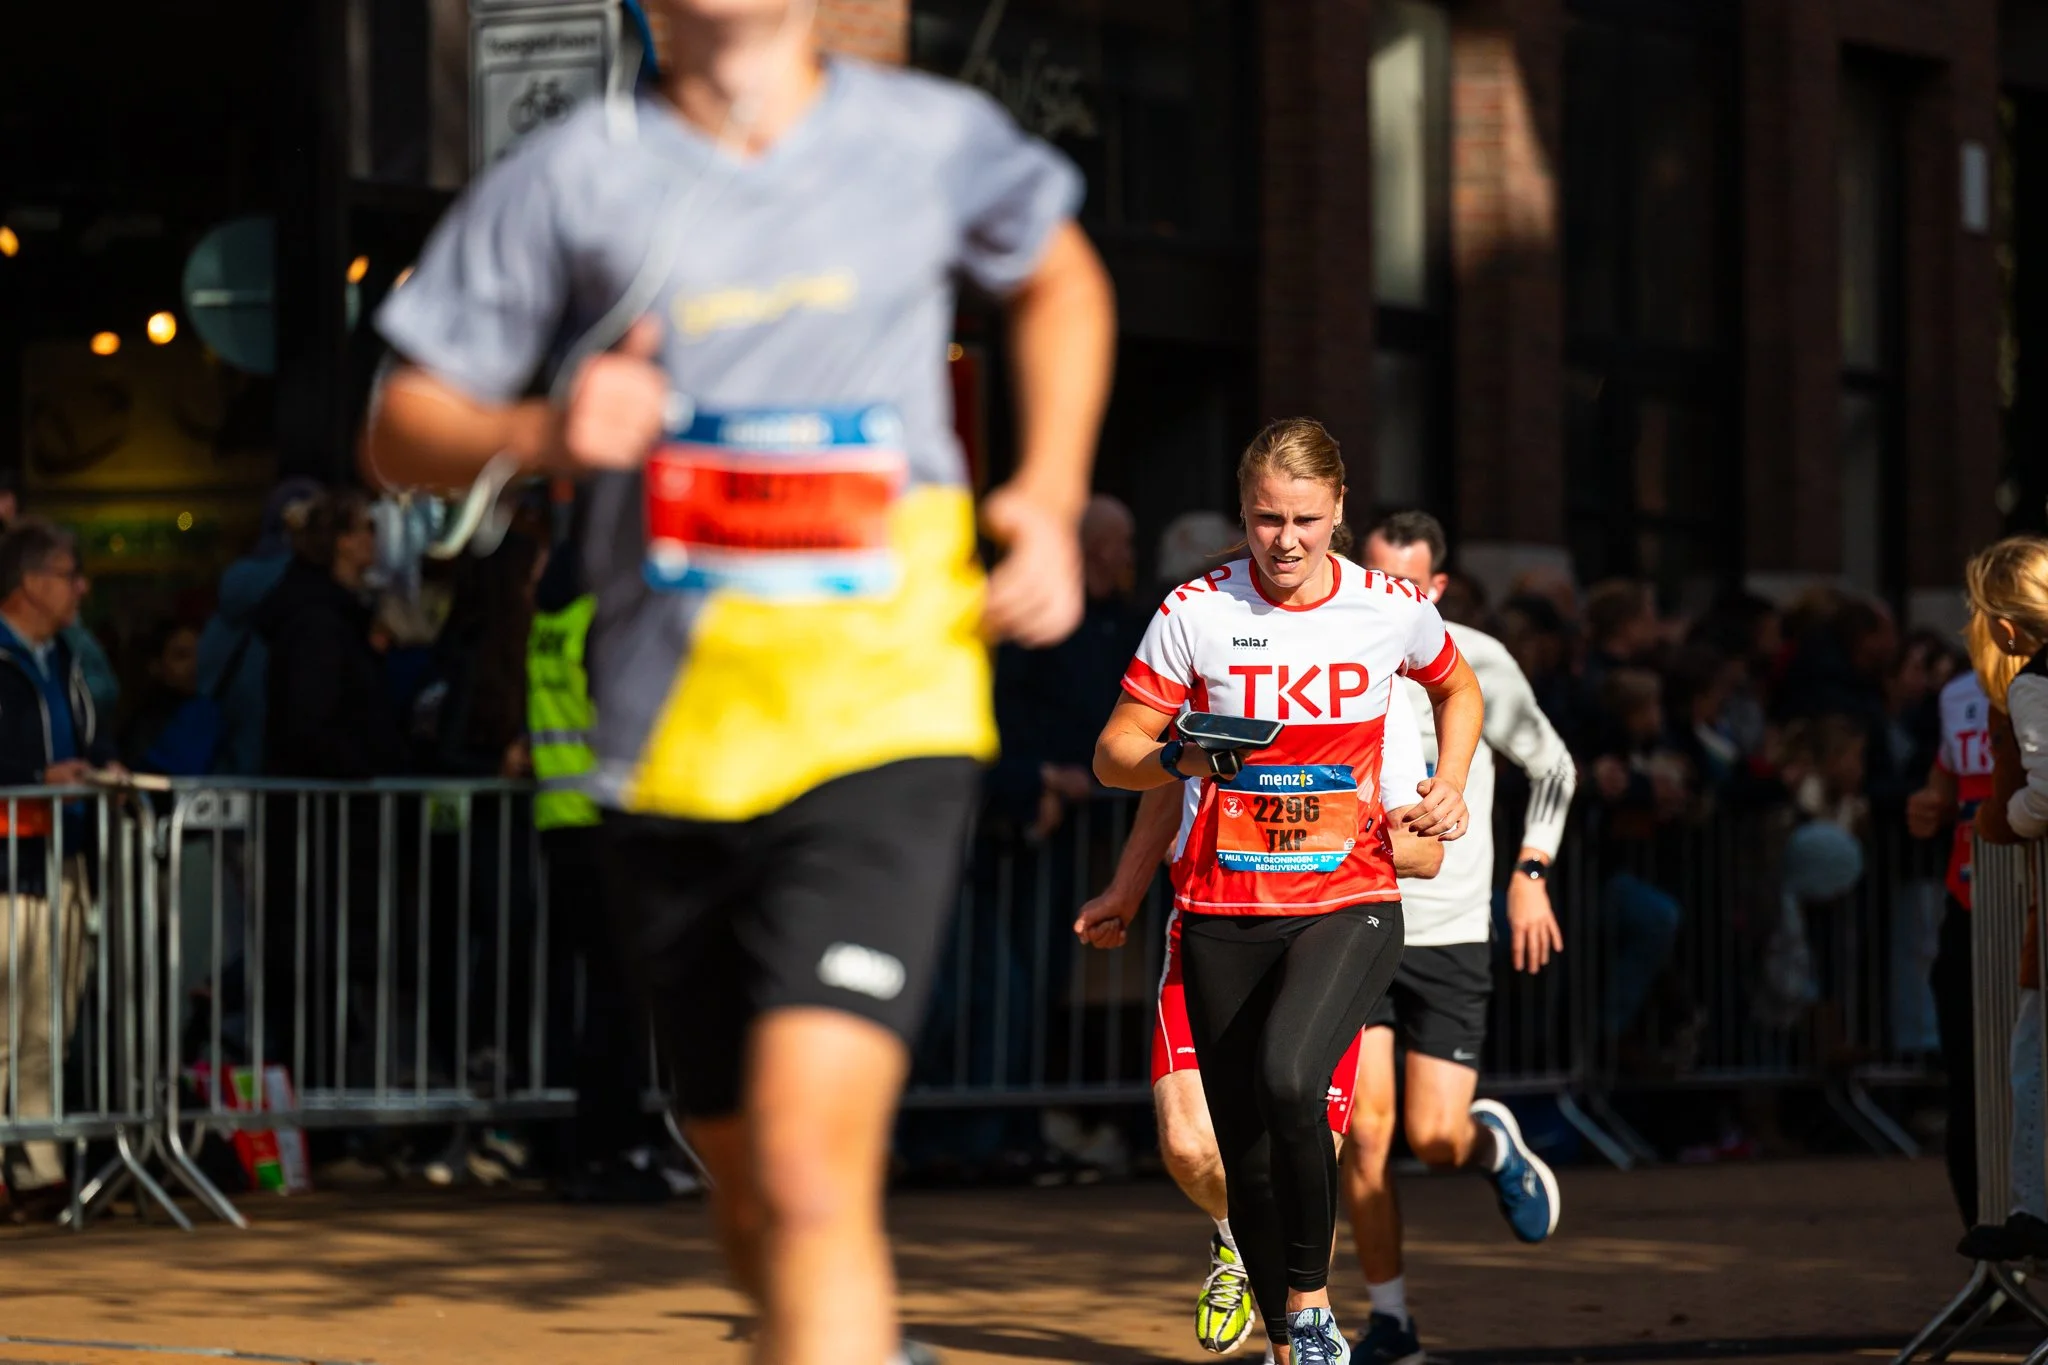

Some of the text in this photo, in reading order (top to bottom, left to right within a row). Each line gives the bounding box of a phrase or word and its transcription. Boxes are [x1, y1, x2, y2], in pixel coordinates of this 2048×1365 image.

[1232, 637, 1269, 647] kalas
[1229, 663, 1369, 720] TKP
[1259, 770, 1313, 787] menzis
[1229, 801, 1238, 813] 2
[1253, 796, 1320, 823] 2296
[1266, 829, 1307, 851] TKP
